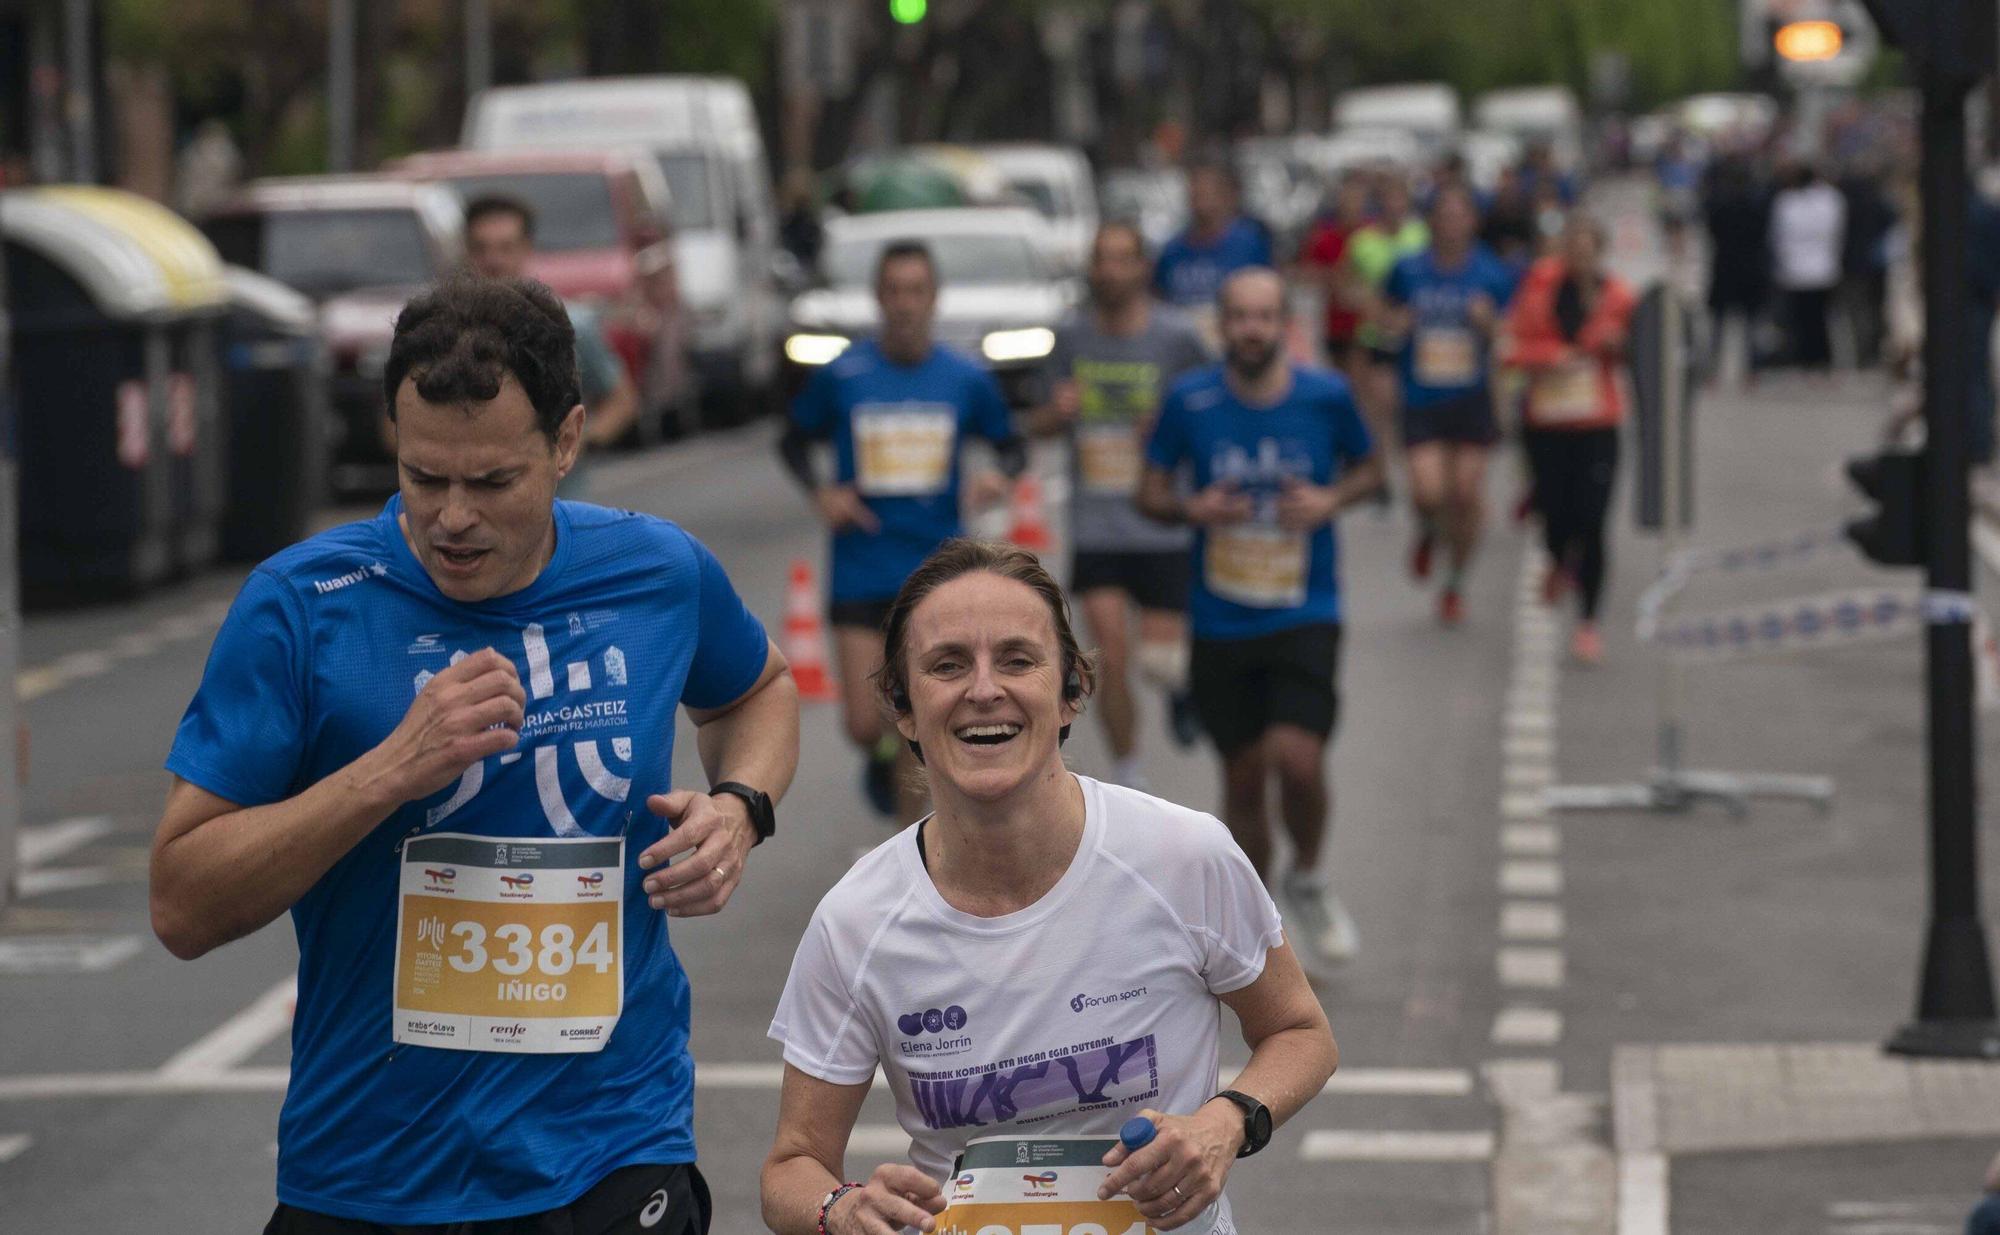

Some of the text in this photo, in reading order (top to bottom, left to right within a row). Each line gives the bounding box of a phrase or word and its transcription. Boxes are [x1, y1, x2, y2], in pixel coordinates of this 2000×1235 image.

[314, 566, 370, 595] luanvi
[534, 722, 568, 736] MARTIN
[569, 720, 584, 731] FIZ
[447, 920, 614, 976] 3384
[497, 979, 568, 1001] IÑIGO
[1119, 986, 1147, 1001] sport
[490, 1023, 527, 1038] renfe
[560, 1028, 600, 1037] EL CORREO
[901, 1035, 972, 1053] Elena Jorrín
[956, 1062, 997, 1077] KORRIKA
[998, 1058, 1015, 1070] ETA
[1017, 1051, 1047, 1065] HEGAN
[1048, 1046, 1069, 1059] EGIN
[1071, 1036, 1115, 1054] DUTENAK
